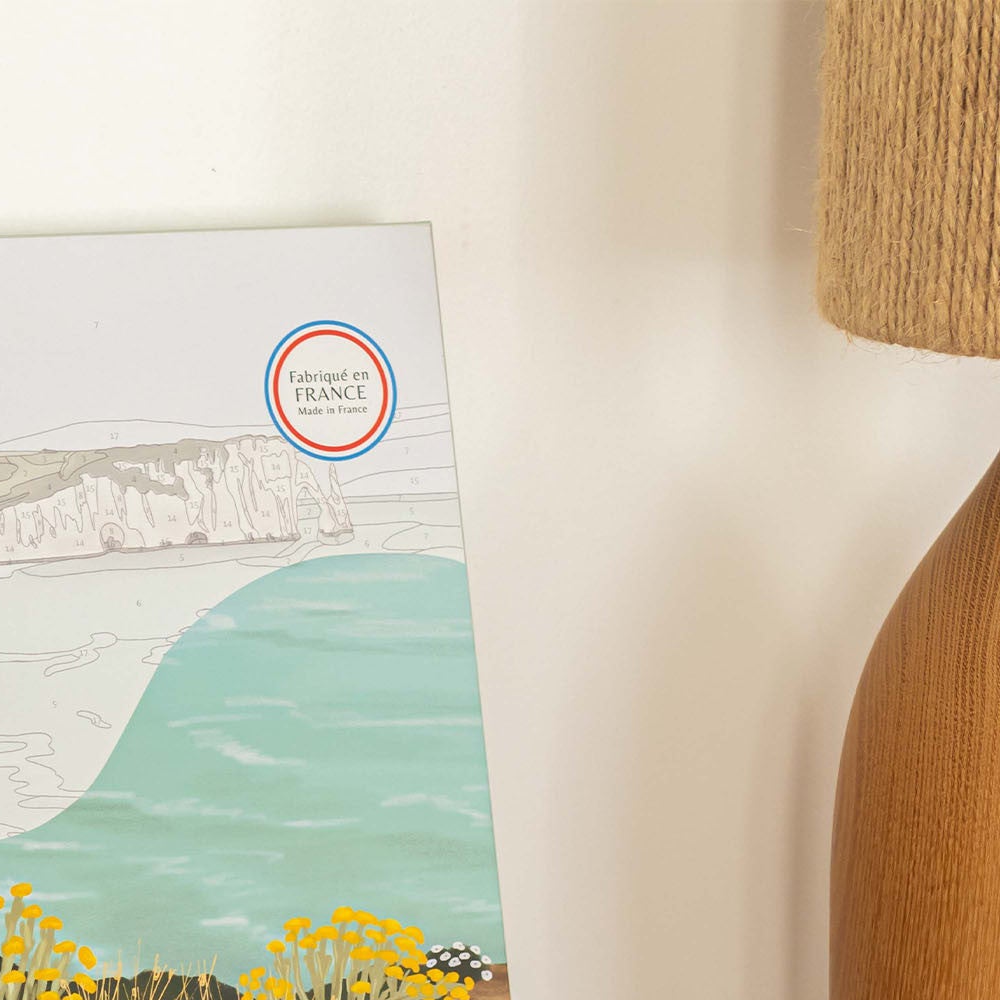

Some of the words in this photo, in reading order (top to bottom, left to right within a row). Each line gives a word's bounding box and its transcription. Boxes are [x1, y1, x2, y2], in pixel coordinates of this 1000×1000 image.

[289, 368, 349, 385] Fabriqué
[352, 369, 370, 381] en
[295, 385, 367, 402] FRANCE
[298, 406, 324, 416] Made
[326, 405, 335, 415] in
[338, 404, 368, 415] France
